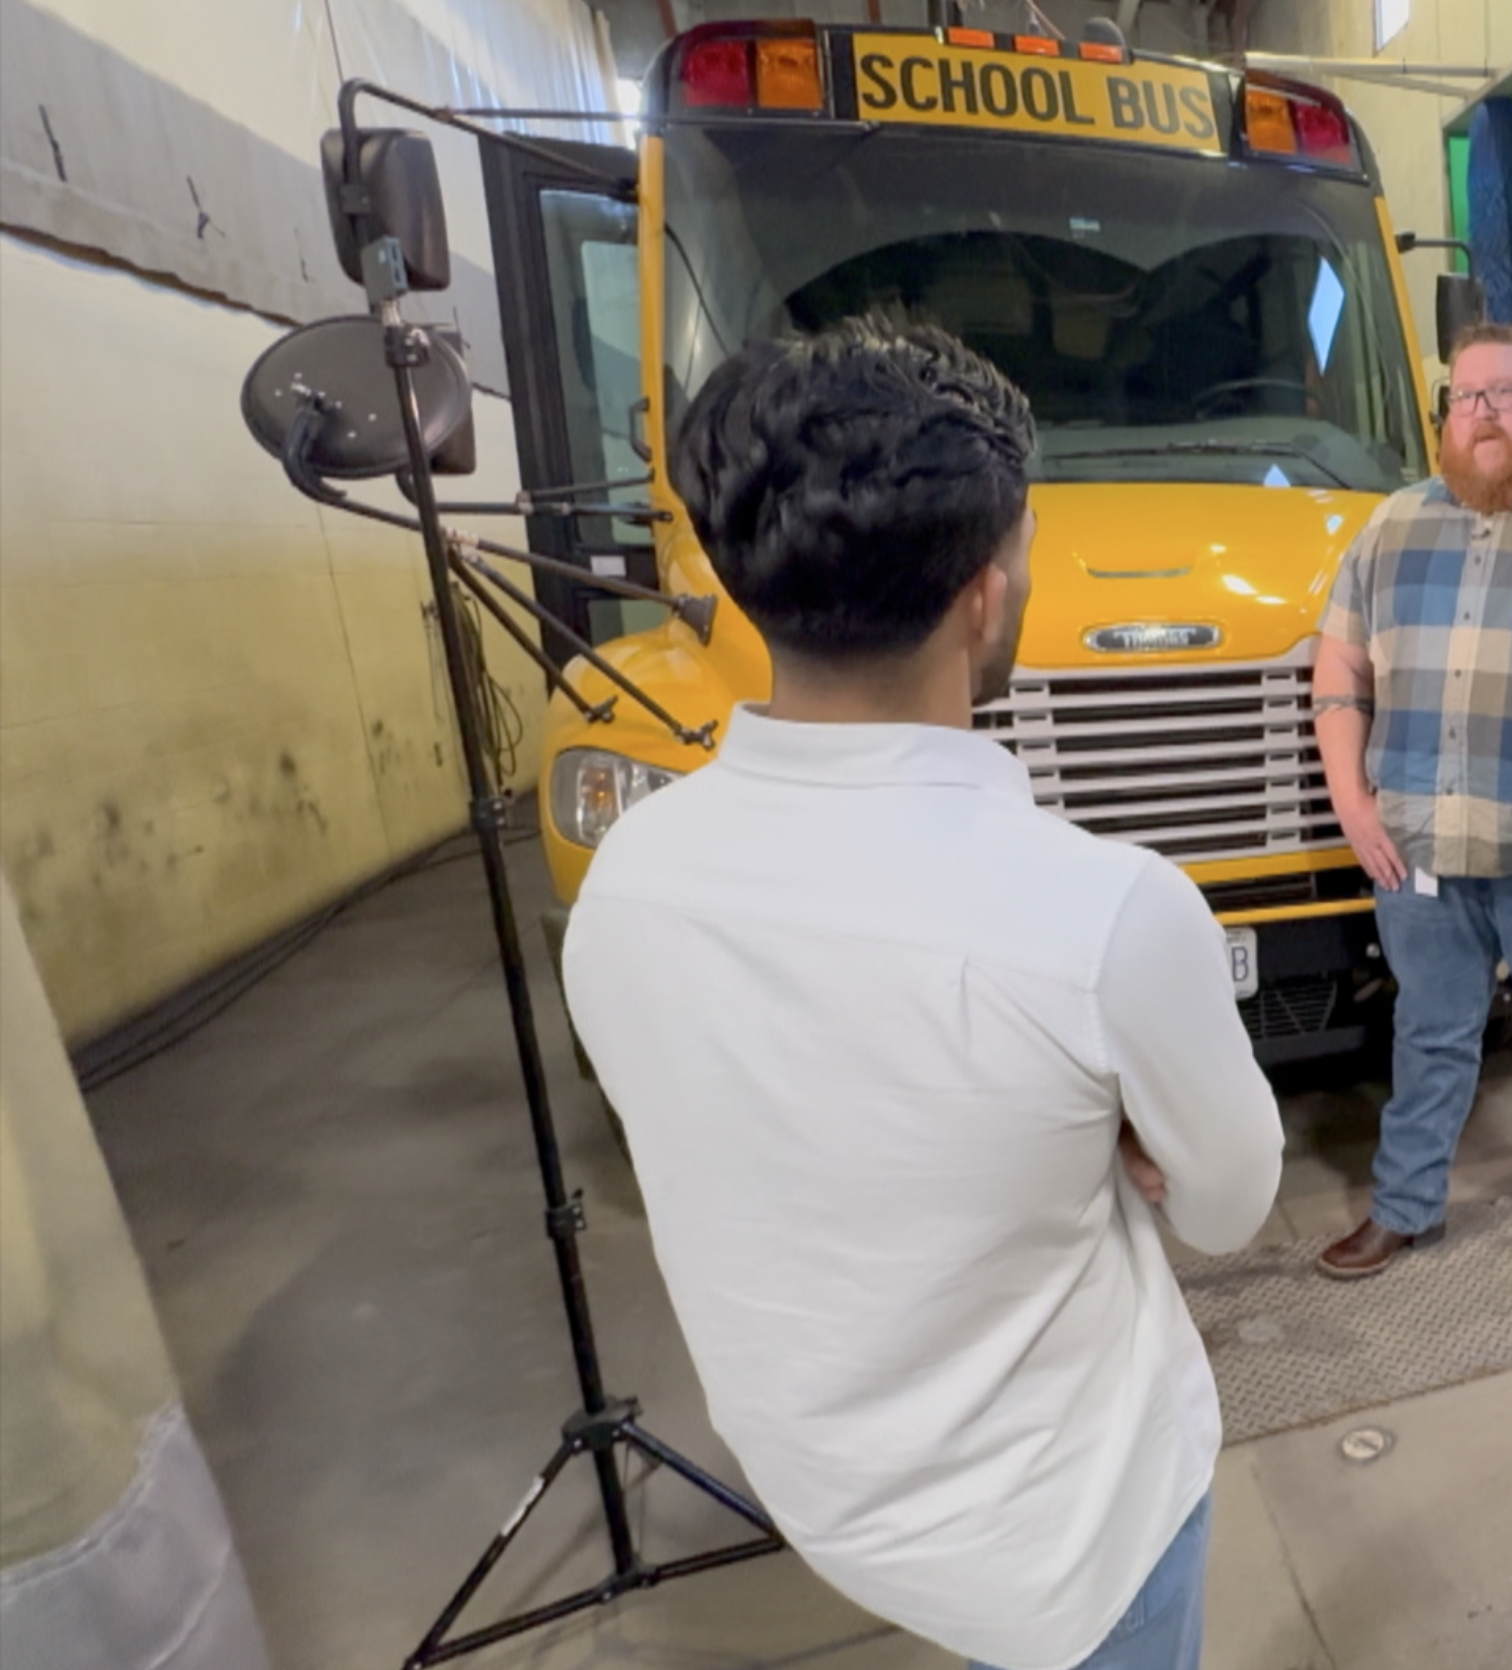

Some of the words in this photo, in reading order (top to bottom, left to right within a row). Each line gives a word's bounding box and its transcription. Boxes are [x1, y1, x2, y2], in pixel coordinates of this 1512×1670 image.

[859, 53, 1096, 126] SCHOOL
[1106, 75, 1216, 140] BUS
[1231, 946, 1249, 983] B
